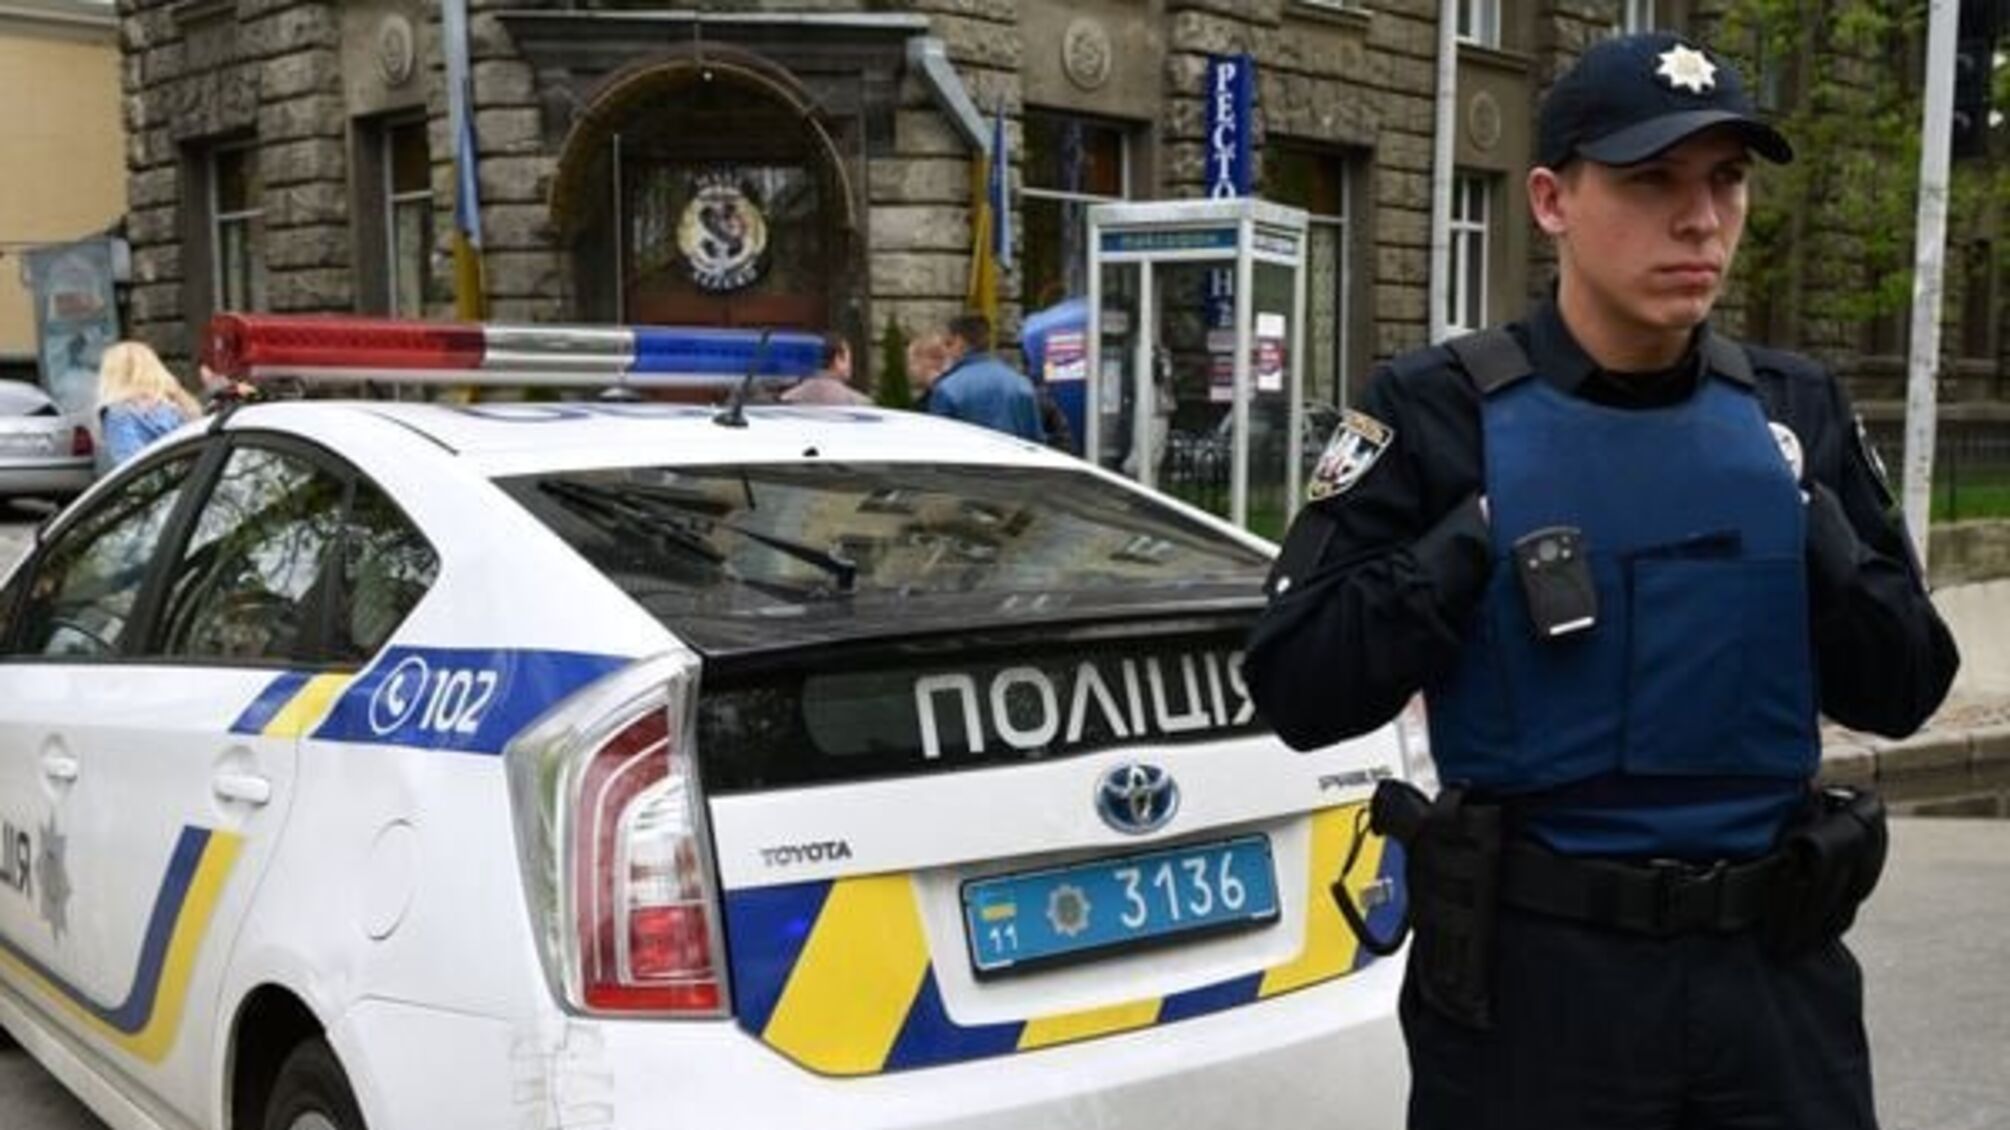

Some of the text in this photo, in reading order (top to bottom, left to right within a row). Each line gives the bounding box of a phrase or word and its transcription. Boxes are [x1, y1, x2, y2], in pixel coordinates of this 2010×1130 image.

[419, 669, 498, 733] 102
[760, 839, 853, 868] TOYOTA
[1114, 852, 1246, 928] 3136
[989, 923, 1018, 954] 11
